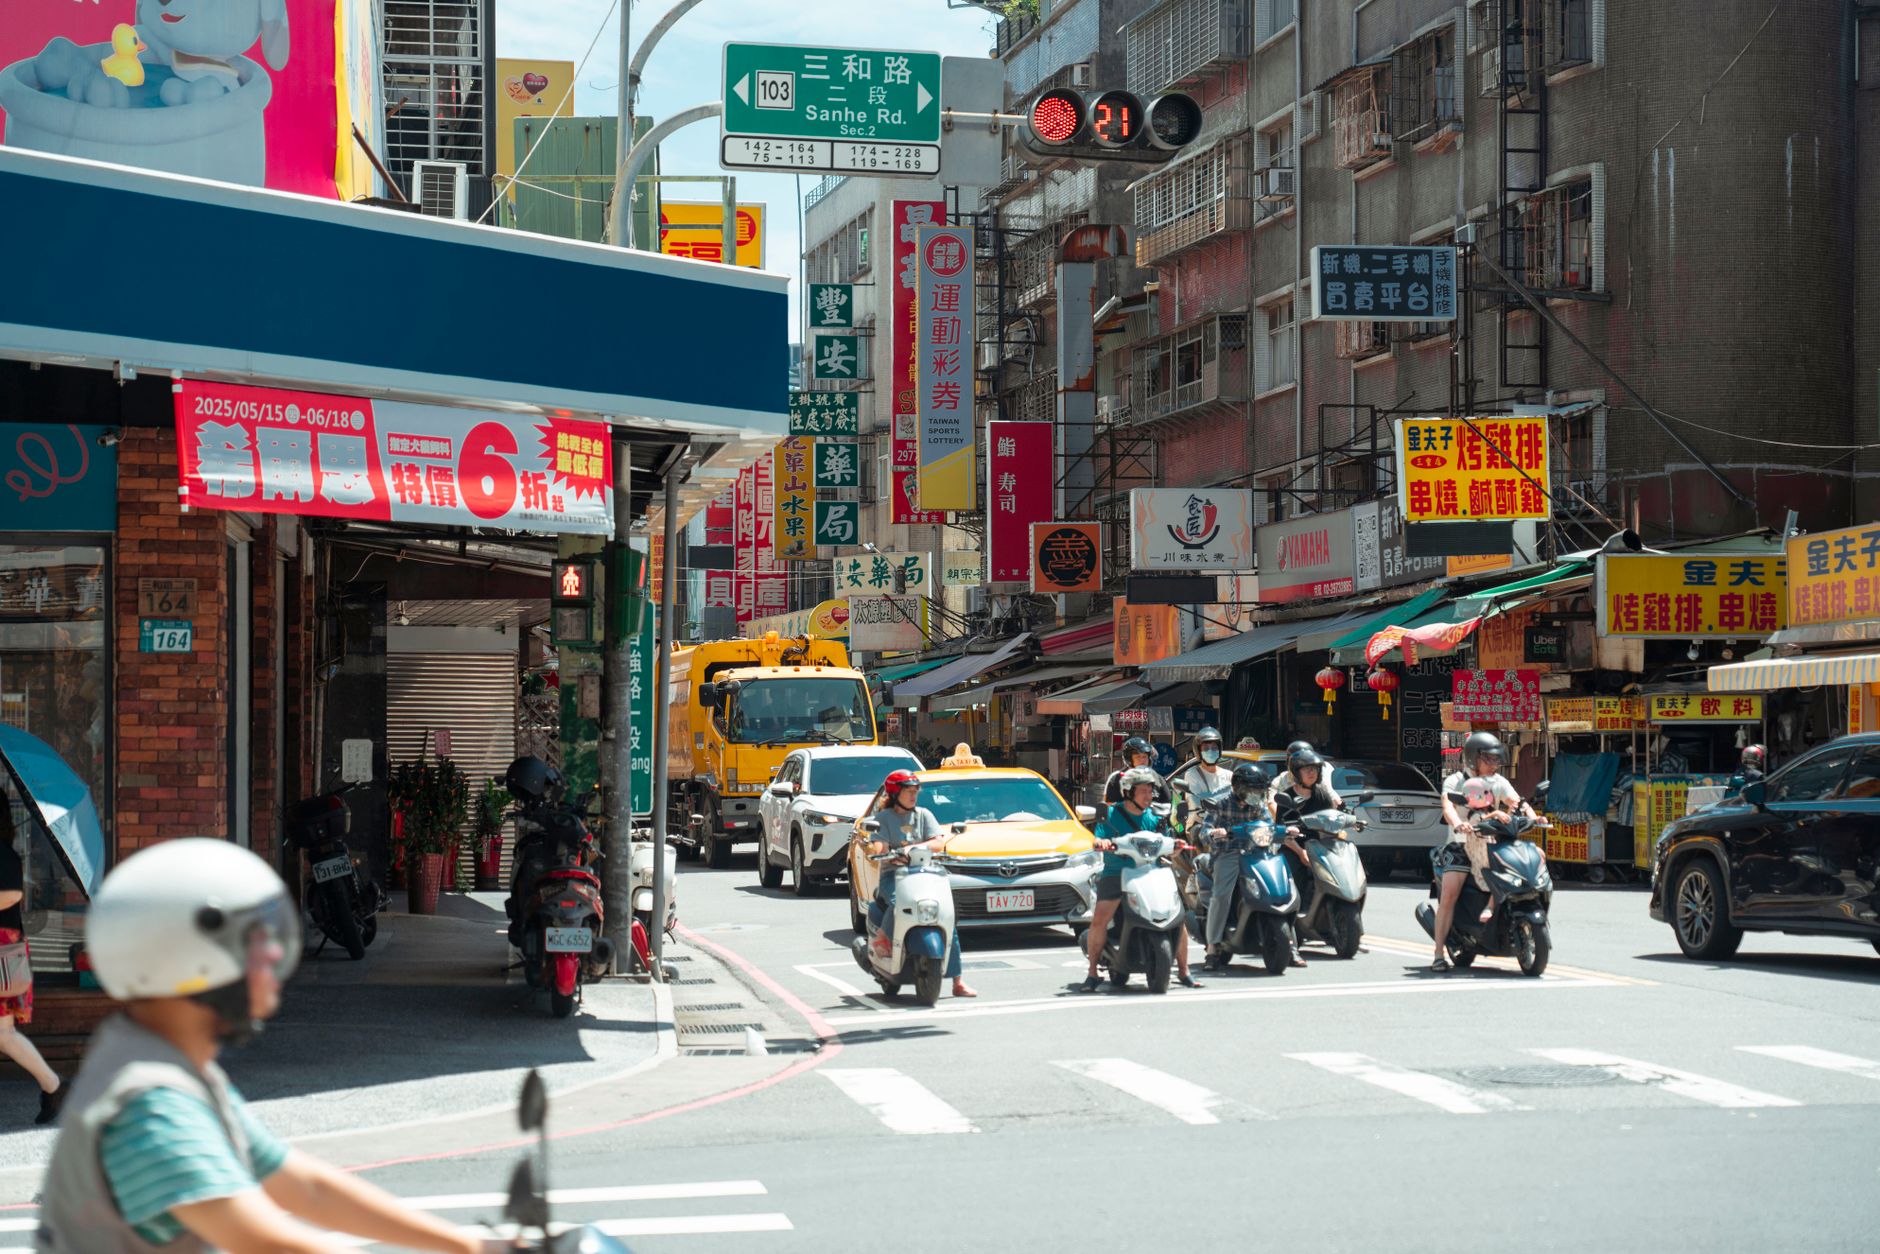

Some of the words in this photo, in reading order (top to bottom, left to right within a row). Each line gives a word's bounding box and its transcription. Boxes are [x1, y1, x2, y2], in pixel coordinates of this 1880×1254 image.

[801, 54, 912, 85] 三和路
[760, 80, 790, 101] 103
[827, 86, 888, 106] 二段
[805, 105, 868, 124] Sanhe
[877, 108, 907, 125] Rd.
[1094, 104, 1130, 140] 21
[840, 124, 876, 137] Sec.2
[744, 141, 814, 153] 142-164
[850, 146, 922, 158] 174-228
[752, 153, 815, 165] 75-113
[850, 157, 922, 169] 119-169
[1326, 280, 1430, 311] 買賣平台
[930, 282, 962, 411] 運動彩券
[928, 427, 960, 435] SPORTS
[1407, 425, 1453, 451] 金夫子
[1455, 422, 1544, 471] 烤雞排
[1163, 552, 1226, 563] 川味水煮
[1287, 528, 1331, 570] YAMAHA
[145, 590, 190, 613] 164
[156, 630, 189, 649] 164
[1533, 634, 1558, 645] Uber
[1533, 645, 1558, 655] Eats
[1700, 697, 1754, 717] 飲料
